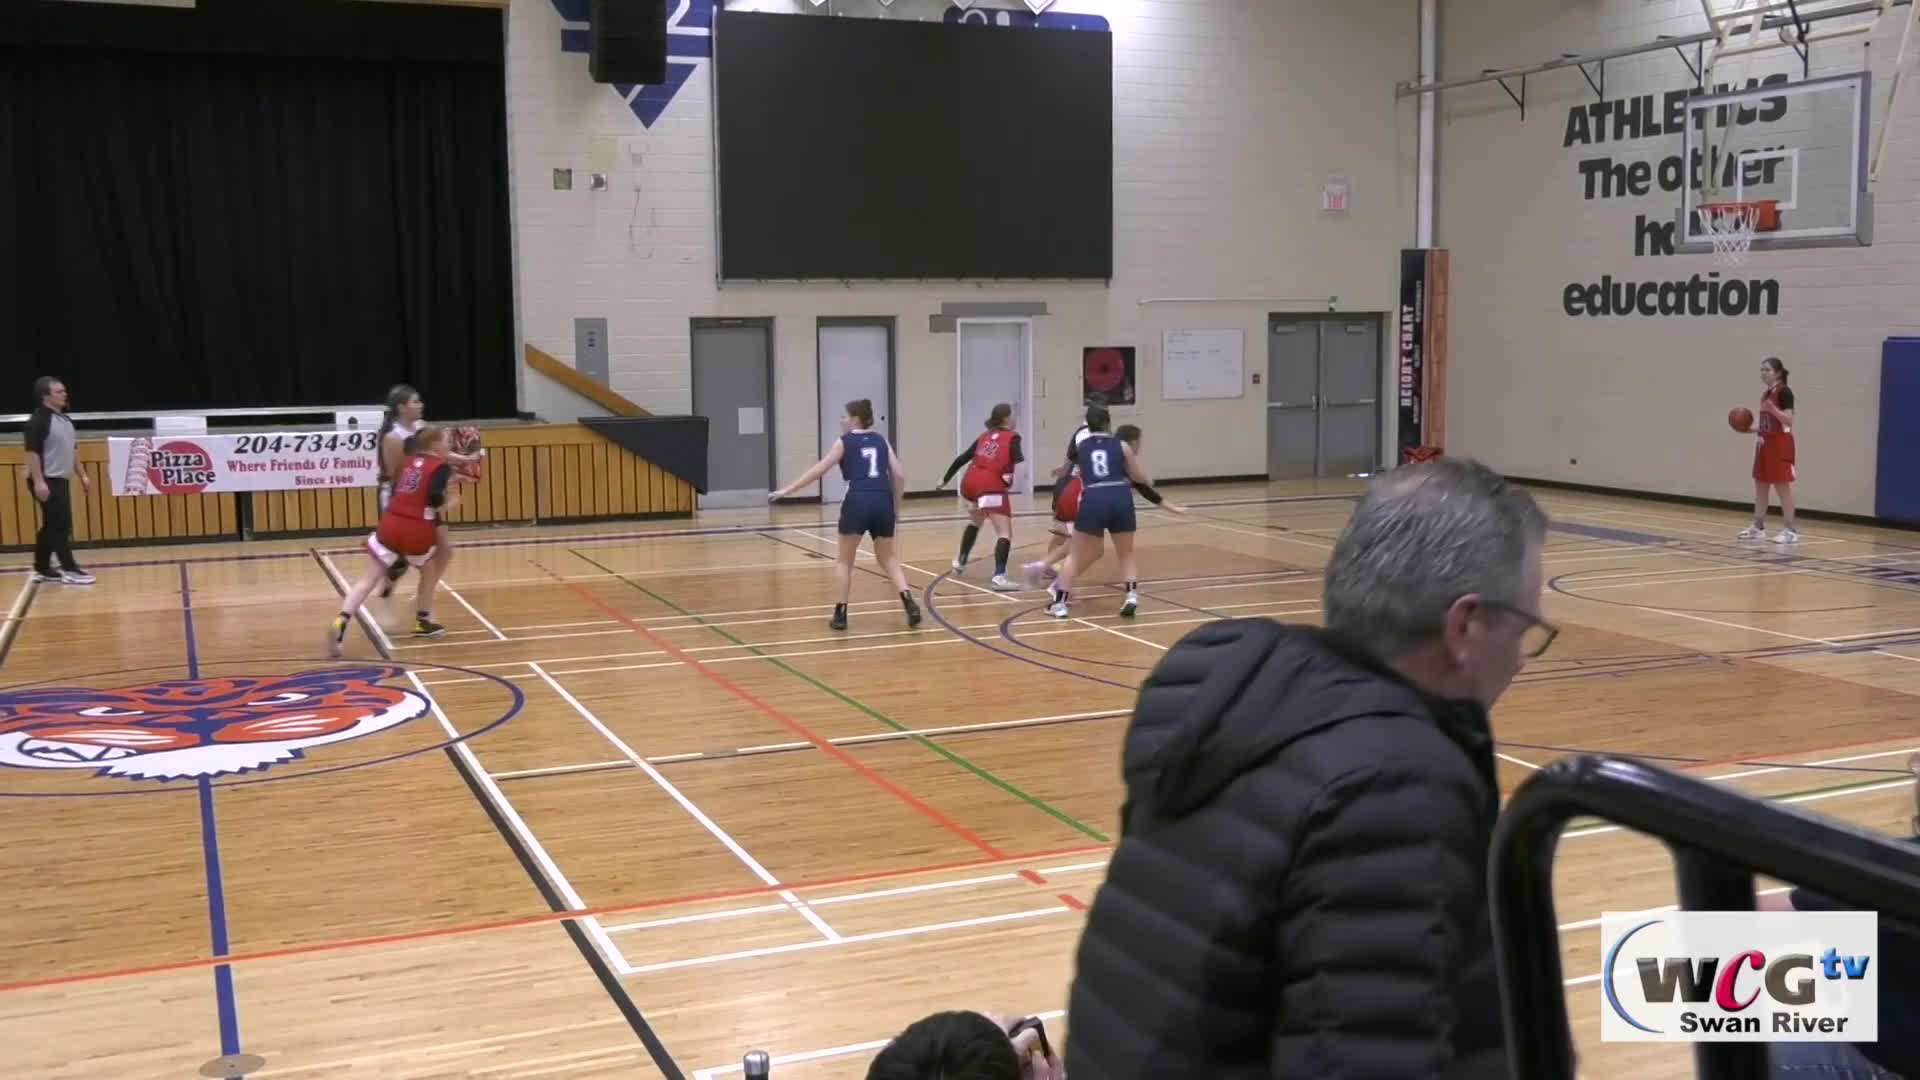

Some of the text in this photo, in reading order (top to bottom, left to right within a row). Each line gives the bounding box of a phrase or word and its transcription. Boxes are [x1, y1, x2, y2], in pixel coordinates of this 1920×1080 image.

[1579, 158, 1651, 200] The
[1563, 272, 1780, 316] education
[1402, 304, 1414, 351] CHART
[234, 432, 377, 454] 204-734-93
[151, 451, 204, 468] Pizza
[227, 459, 267, 473] Where
[270, 458, 316, 471] Friends
[334, 456, 373, 470] Family
[861, 447, 879, 478] 7
[1090, 449, 1110, 477] 8
[163, 468, 217, 485] Place
[295, 475, 325, 486] Since
